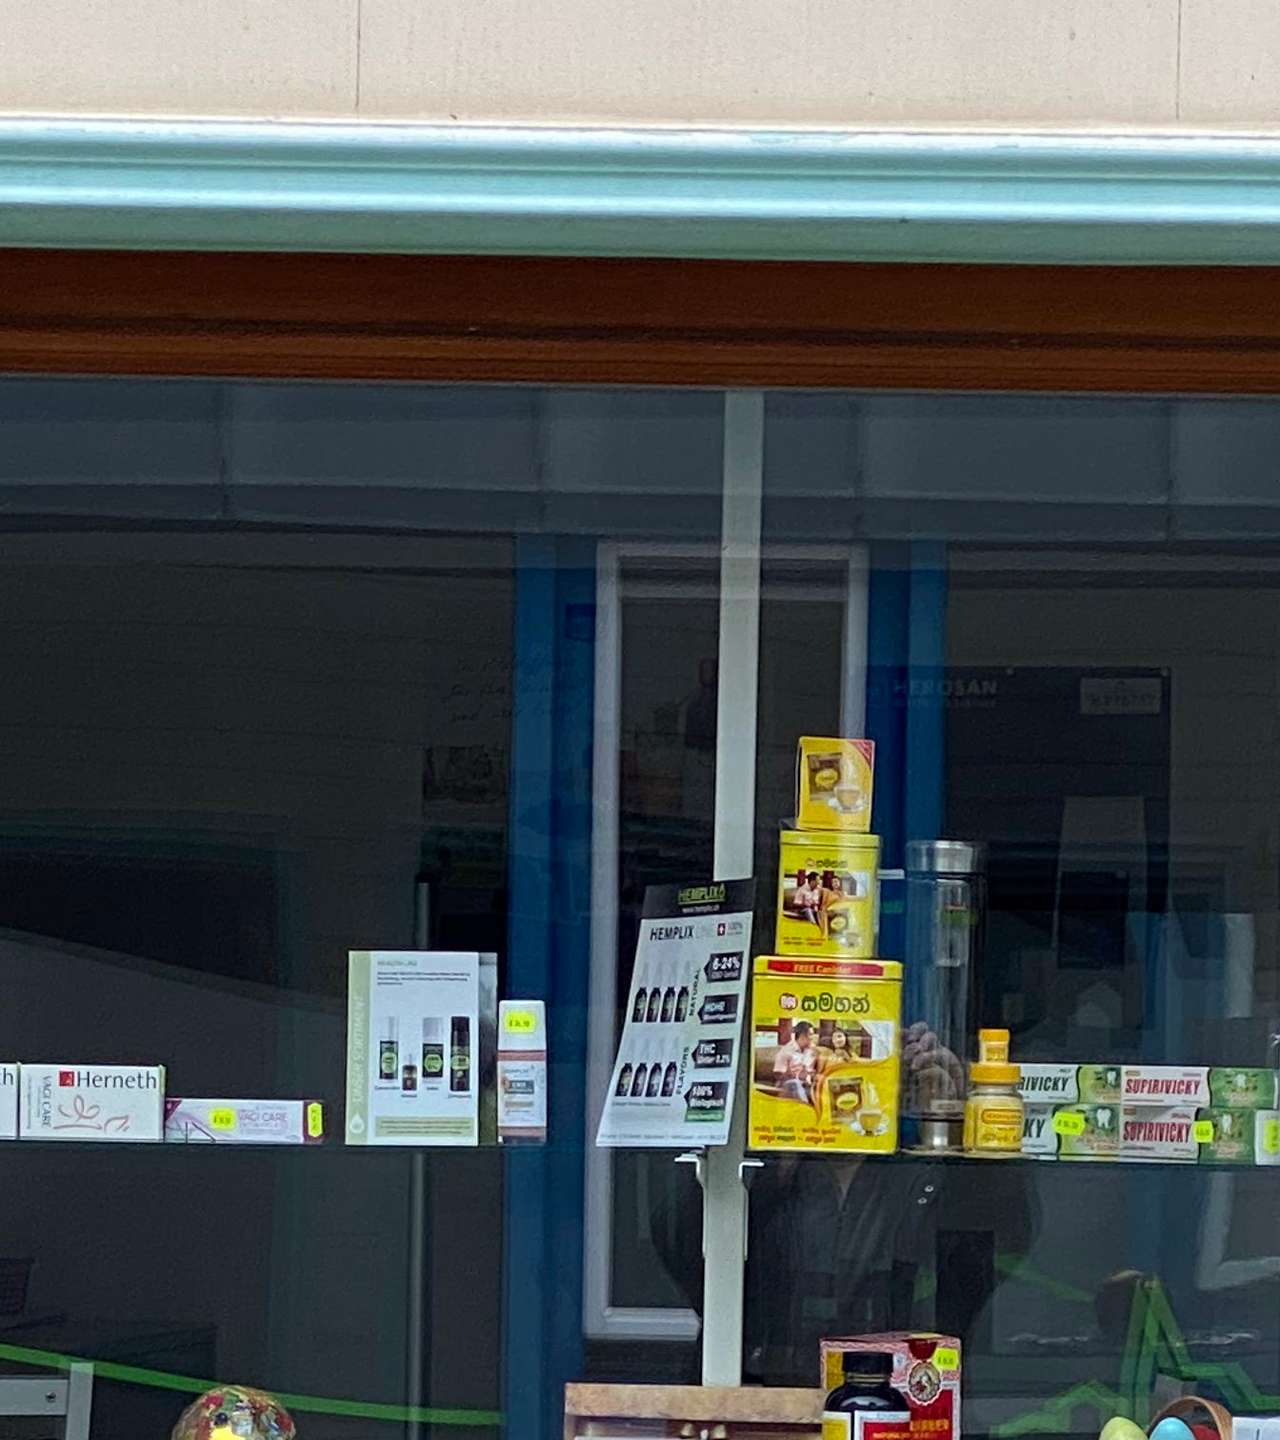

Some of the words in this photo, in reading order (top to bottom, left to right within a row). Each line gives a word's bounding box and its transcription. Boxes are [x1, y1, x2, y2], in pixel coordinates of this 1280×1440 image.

[649, 924, 695, 941] HEMPLIX
[688, 967, 702, 1017] NATURAL
[76, 1071, 158, 1089] Herneth
[1016, 1077, 1069, 1092] RIVICKY
[1122, 1120, 1192, 1143] SUPIRIVICKY
